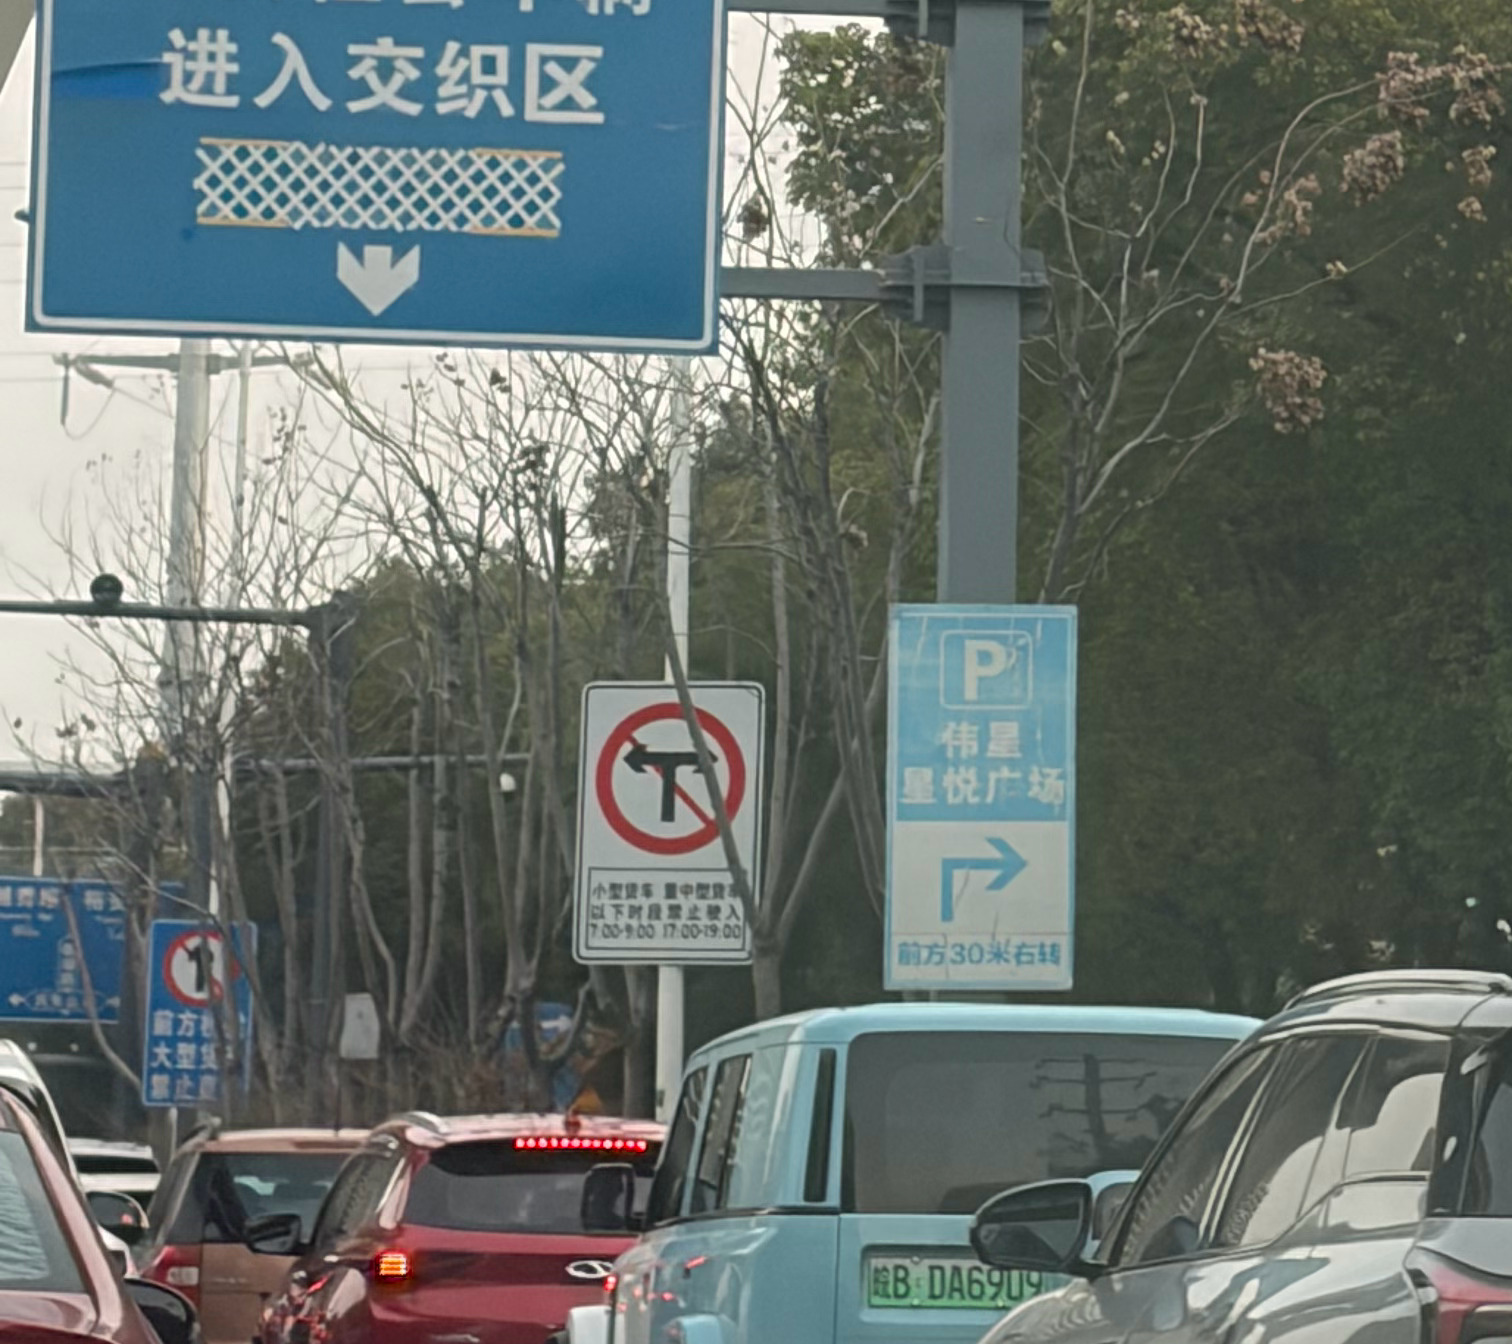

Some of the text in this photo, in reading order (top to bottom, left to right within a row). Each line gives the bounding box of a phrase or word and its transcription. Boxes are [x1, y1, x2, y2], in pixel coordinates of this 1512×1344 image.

[158, 28, 605, 124] 进入交织区
[962, 639, 1008, 702] P
[941, 721, 1022, 759] 伟星
[899, 765, 1065, 806] 星悦广场
[897, 939, 1061, 967] 前方30米右转
